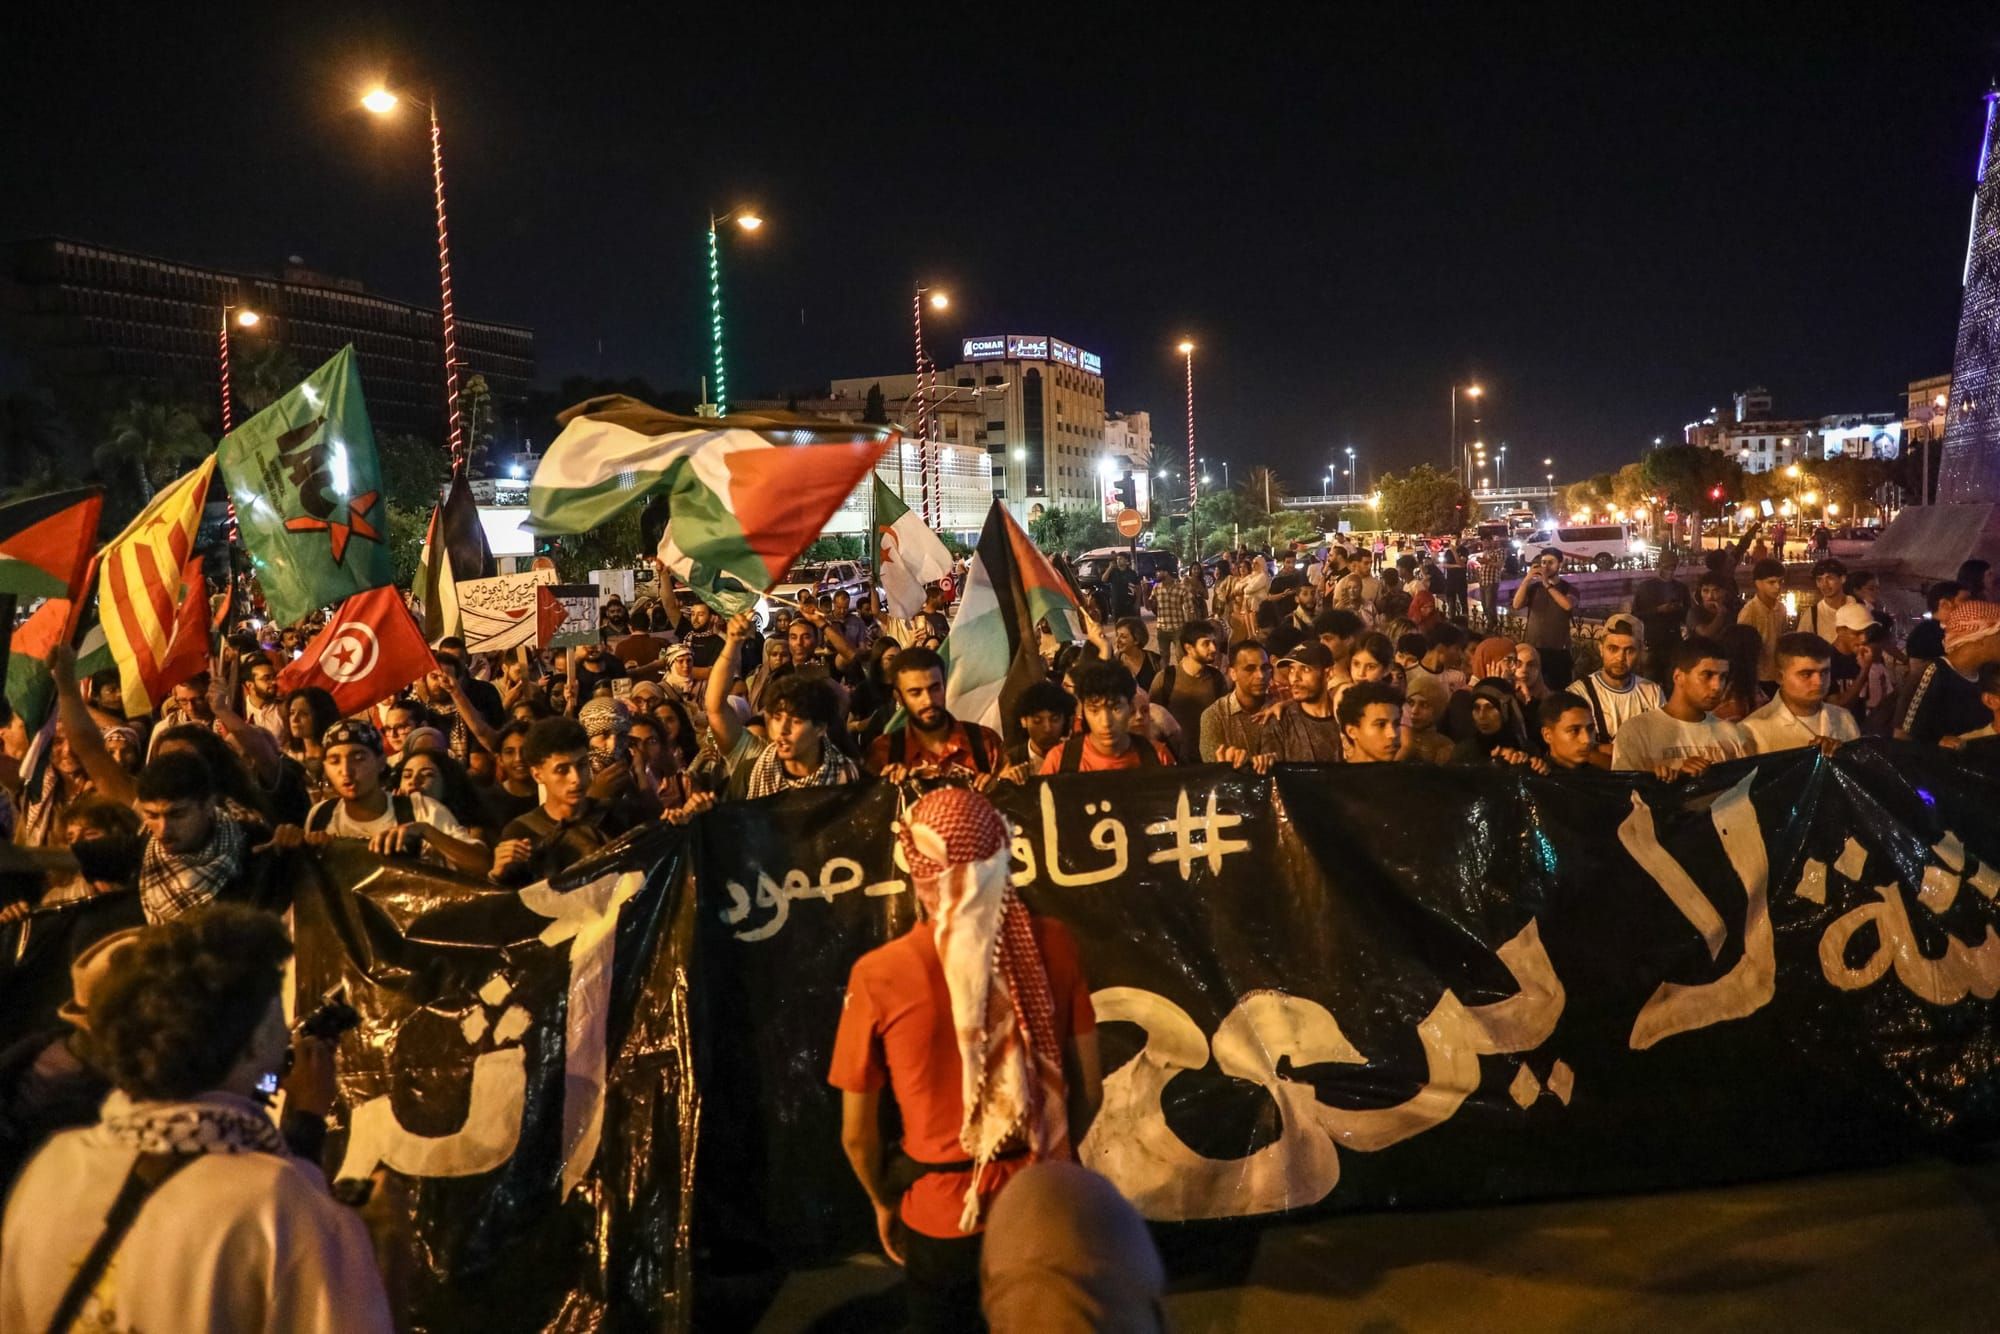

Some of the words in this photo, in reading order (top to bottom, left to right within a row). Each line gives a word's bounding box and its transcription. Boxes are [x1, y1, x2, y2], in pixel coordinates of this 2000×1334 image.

[972, 341, 1004, 351] COMAR
[1017, 339, 1048, 353] كومار
[1617, 766, 1776, 1051] لا
